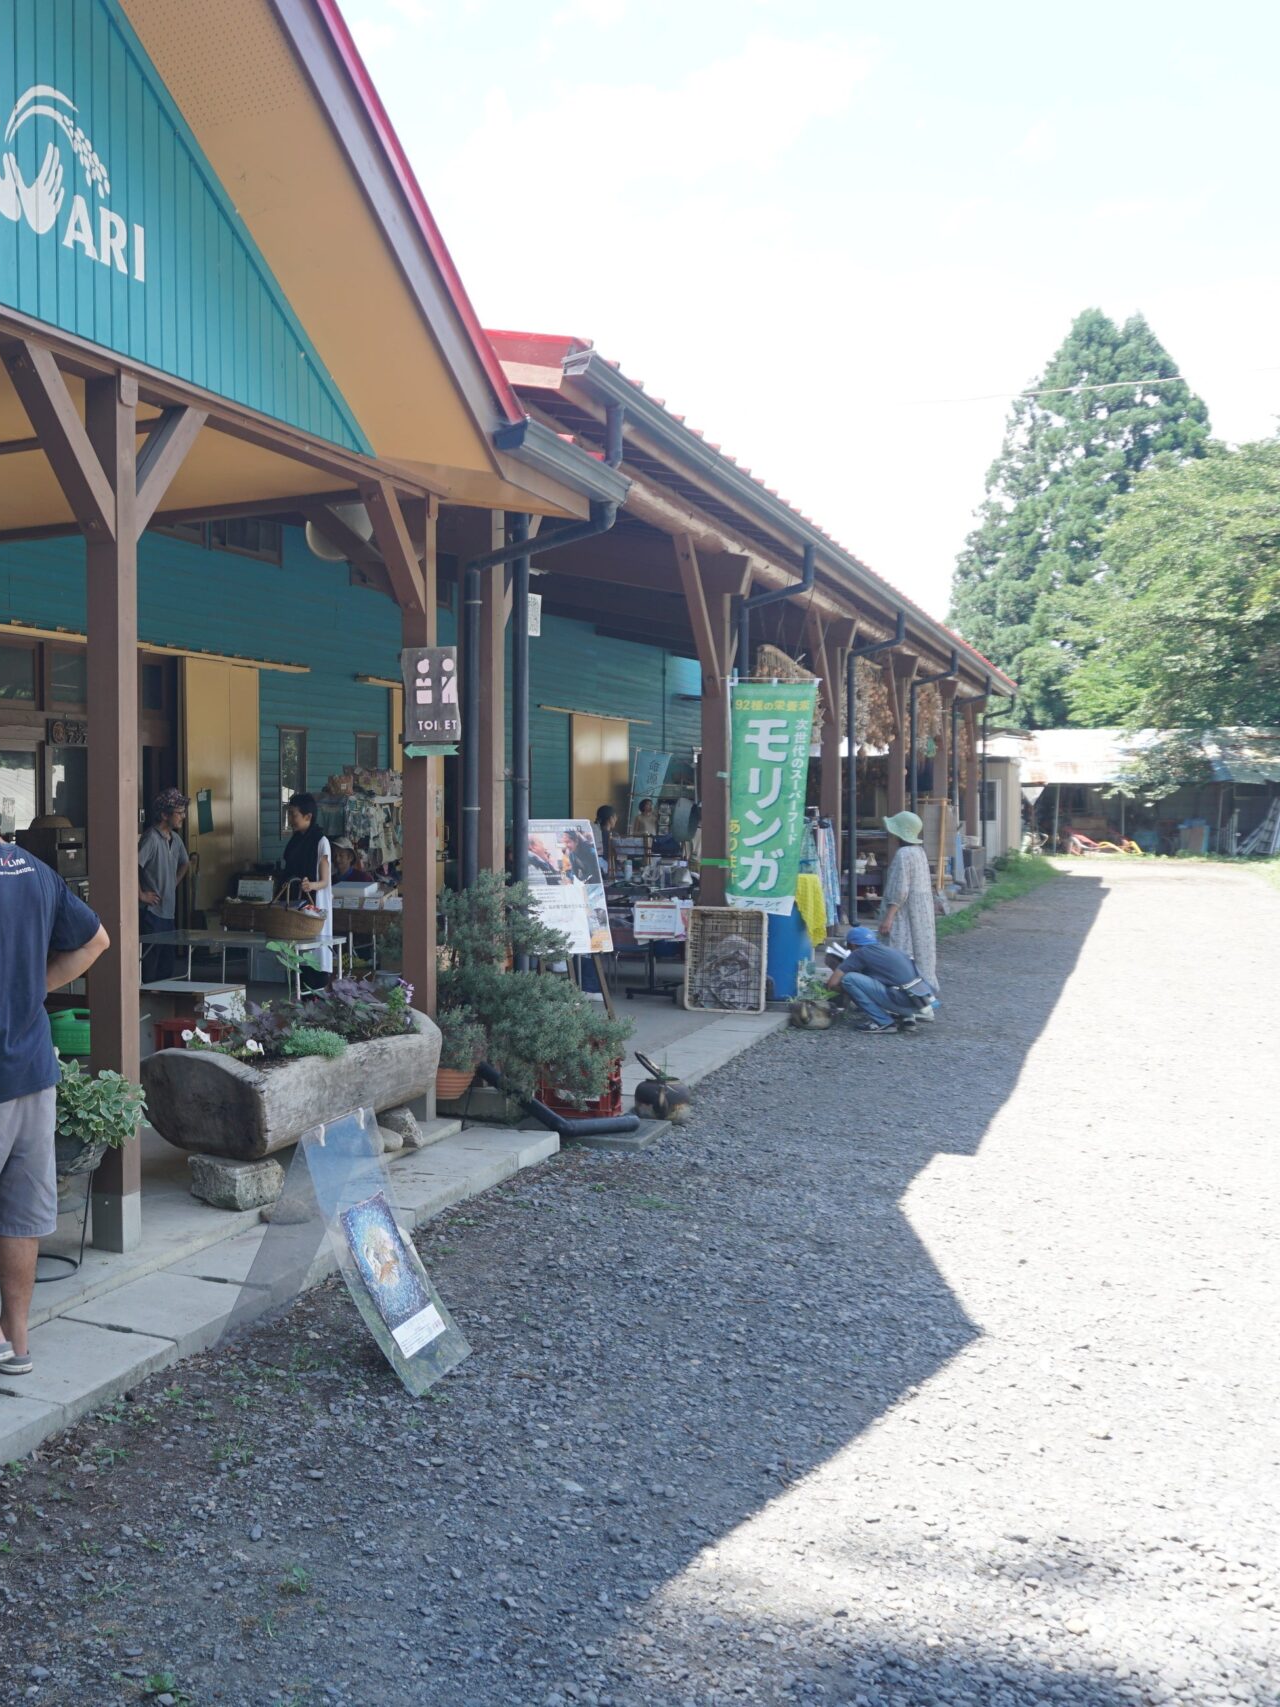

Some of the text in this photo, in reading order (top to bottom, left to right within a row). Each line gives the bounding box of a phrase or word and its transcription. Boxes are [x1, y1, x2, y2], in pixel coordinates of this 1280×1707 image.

[62, 195, 145, 283] ARI
[417, 720, 457, 731] TOIET
[737, 719, 790, 891] モリンガ
[788, 718, 809, 846] 次世代のスーパーフード
